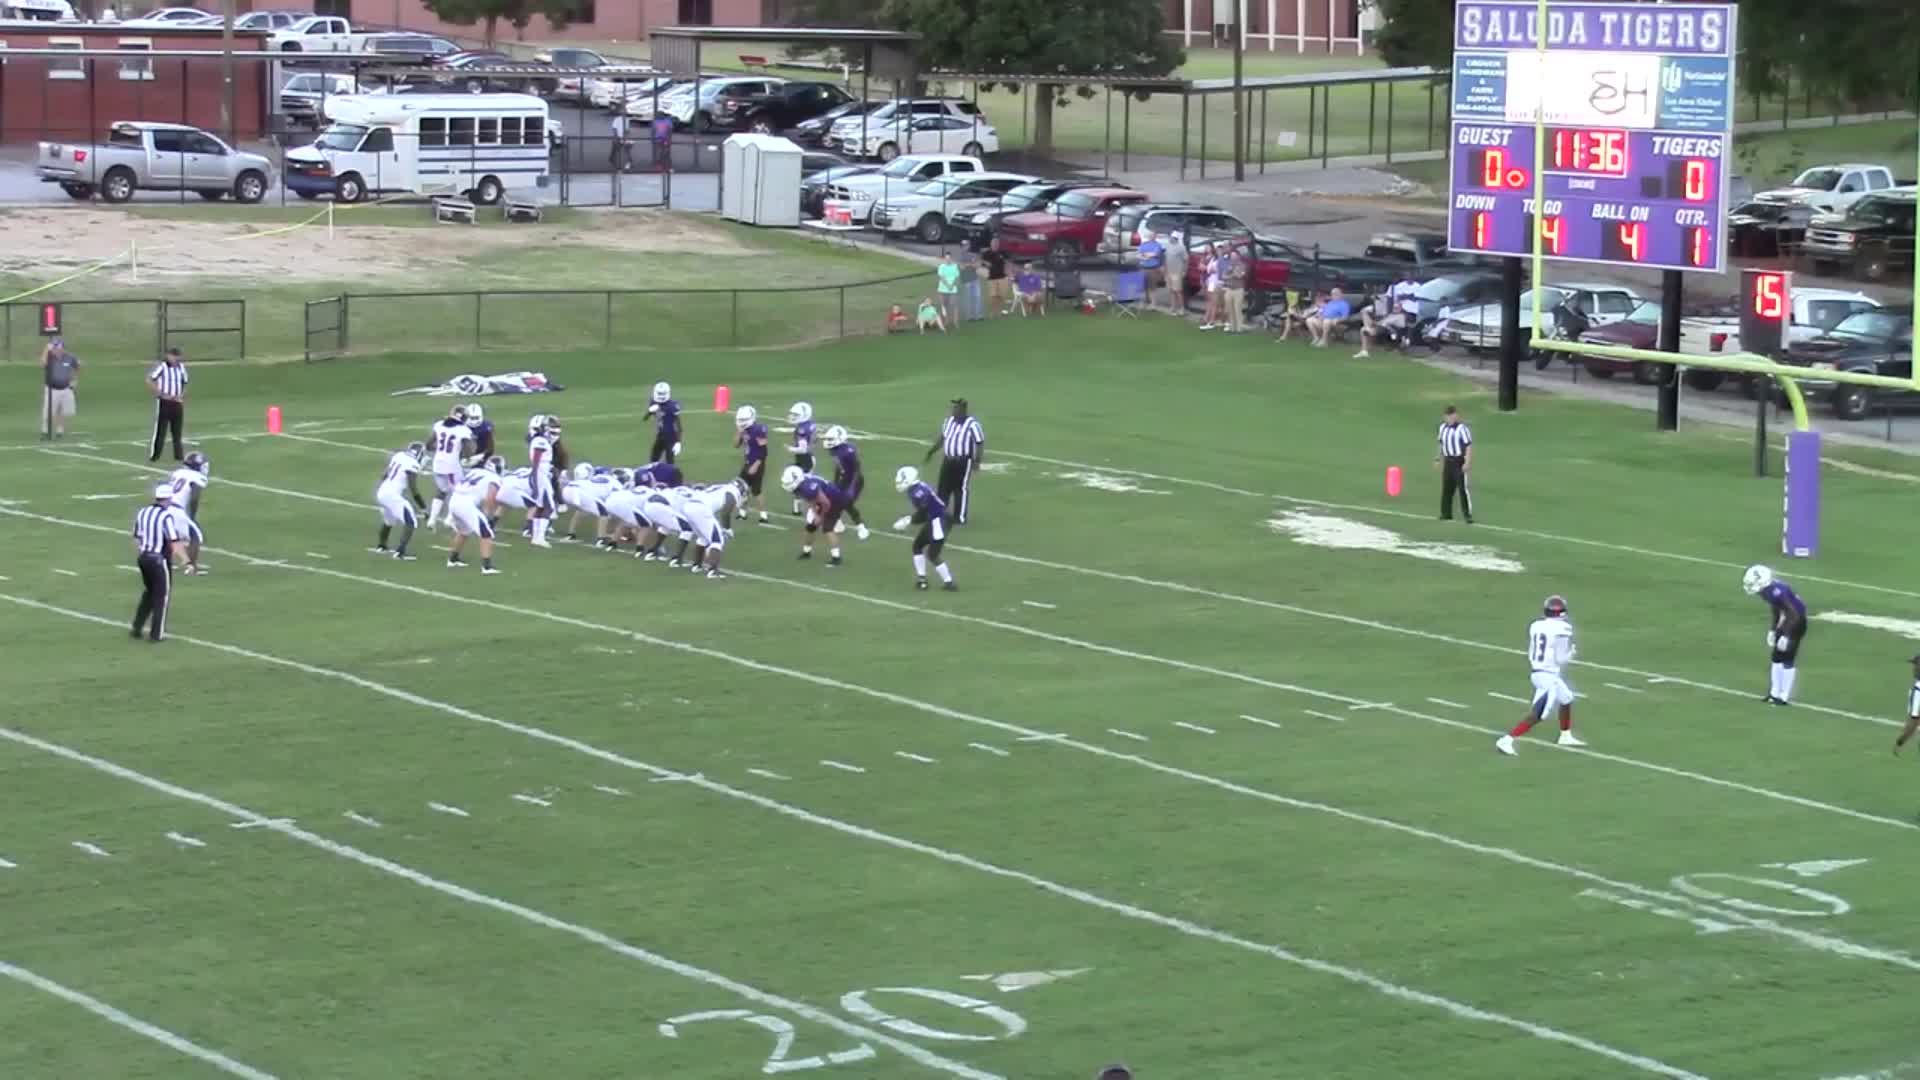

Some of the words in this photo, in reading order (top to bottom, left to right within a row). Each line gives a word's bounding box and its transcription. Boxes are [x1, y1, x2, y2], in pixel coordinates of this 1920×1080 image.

[1464, 8, 1587, 44] SALUDA
[1601, 11, 1723, 49] TIGERS
[1458, 128, 1512, 145] GUEST
[1554, 131, 1623, 172] 11:36
[1652, 137, 1721, 157] TIGERS
[1485, 150, 1502, 188] 0
[1685, 161, 1704, 201] 0
[1456, 195, 1495, 209] DOWN
[1543, 200, 1561, 214] GO
[1592, 203, 1625, 219] BALL
[1631, 206, 1649, 221] ON
[1675, 209, 1709, 225] QTR.
[1542, 219, 1559, 254] 4
[1620, 224, 1638, 260] 4
[1756, 276, 1781, 317] 15
[438, 432, 456, 453] 36
[1532, 633, 1547, 662] 13
[658, 986, 1027, 1074] 20
